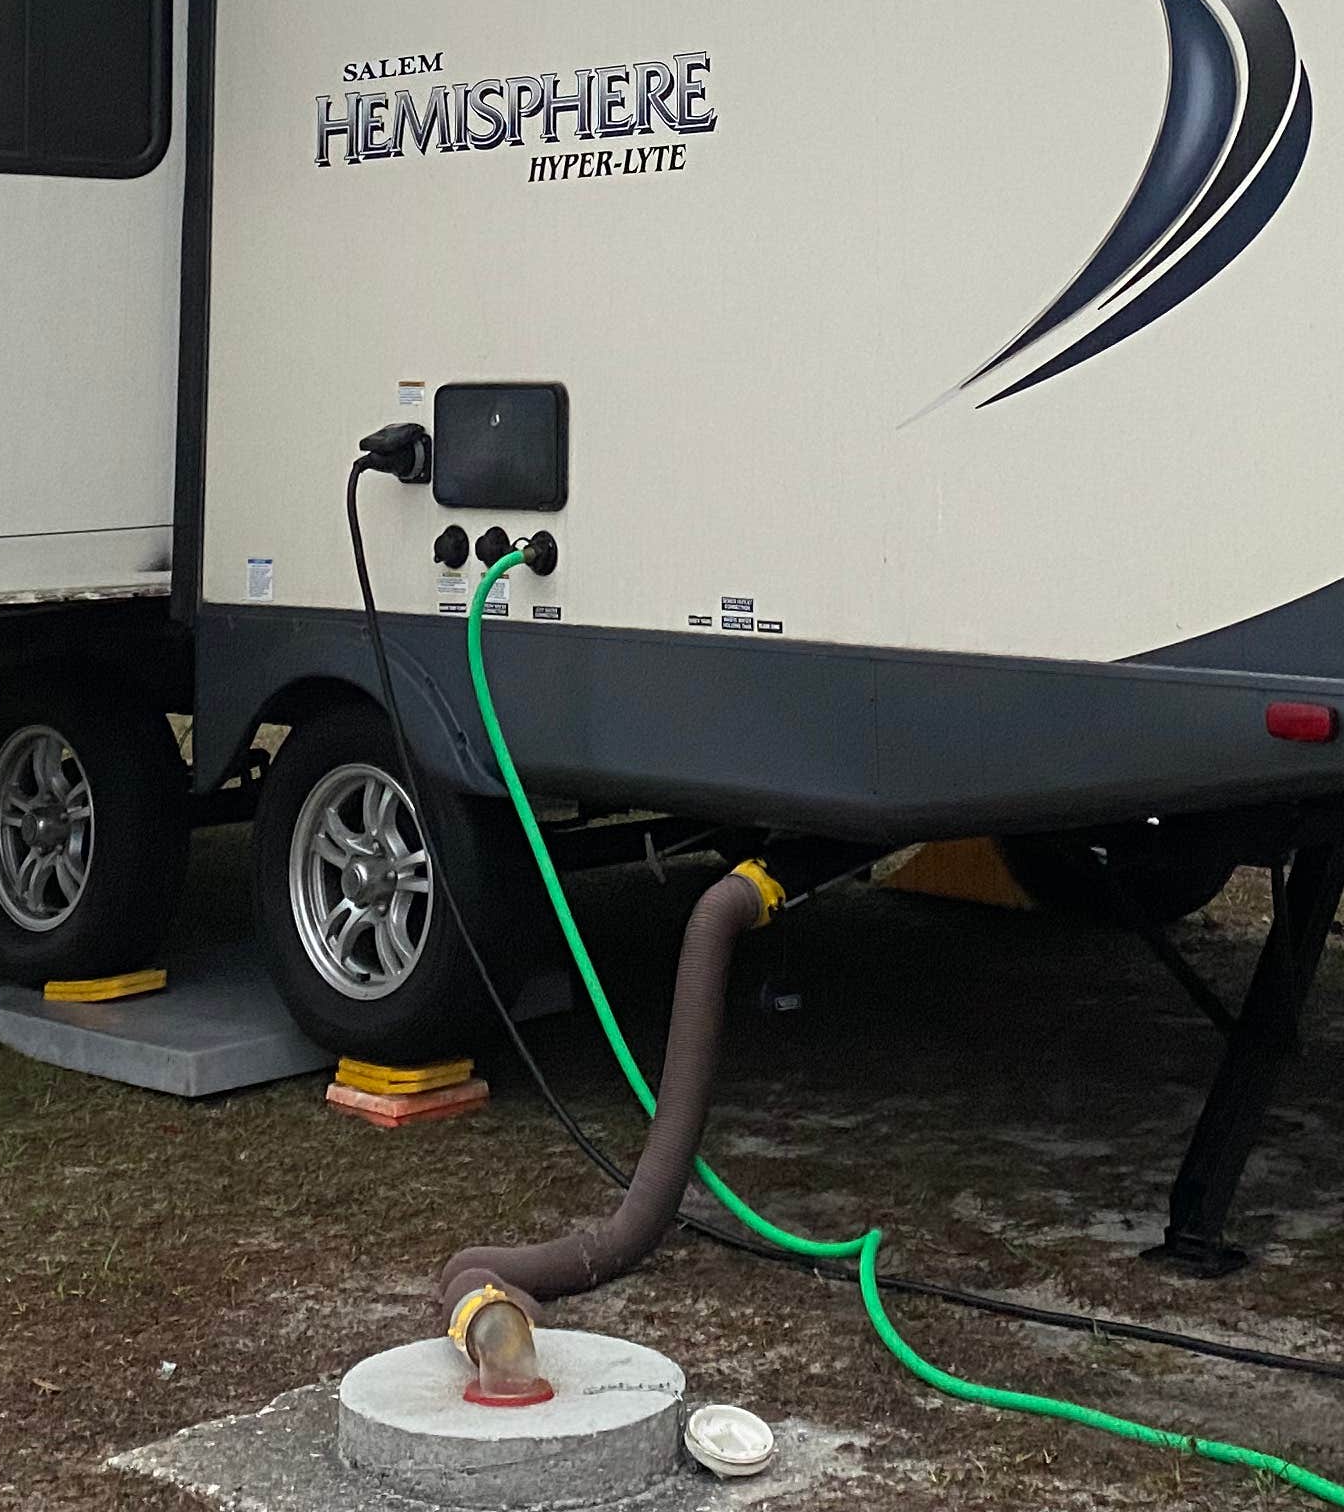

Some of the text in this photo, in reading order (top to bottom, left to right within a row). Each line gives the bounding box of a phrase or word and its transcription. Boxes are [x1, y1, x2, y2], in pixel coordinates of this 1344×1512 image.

[343, 51, 444, 82] SALEM
[314, 51, 719, 167] HEMISPHERE
[527, 144, 688, 183] HYPER-LYTE
